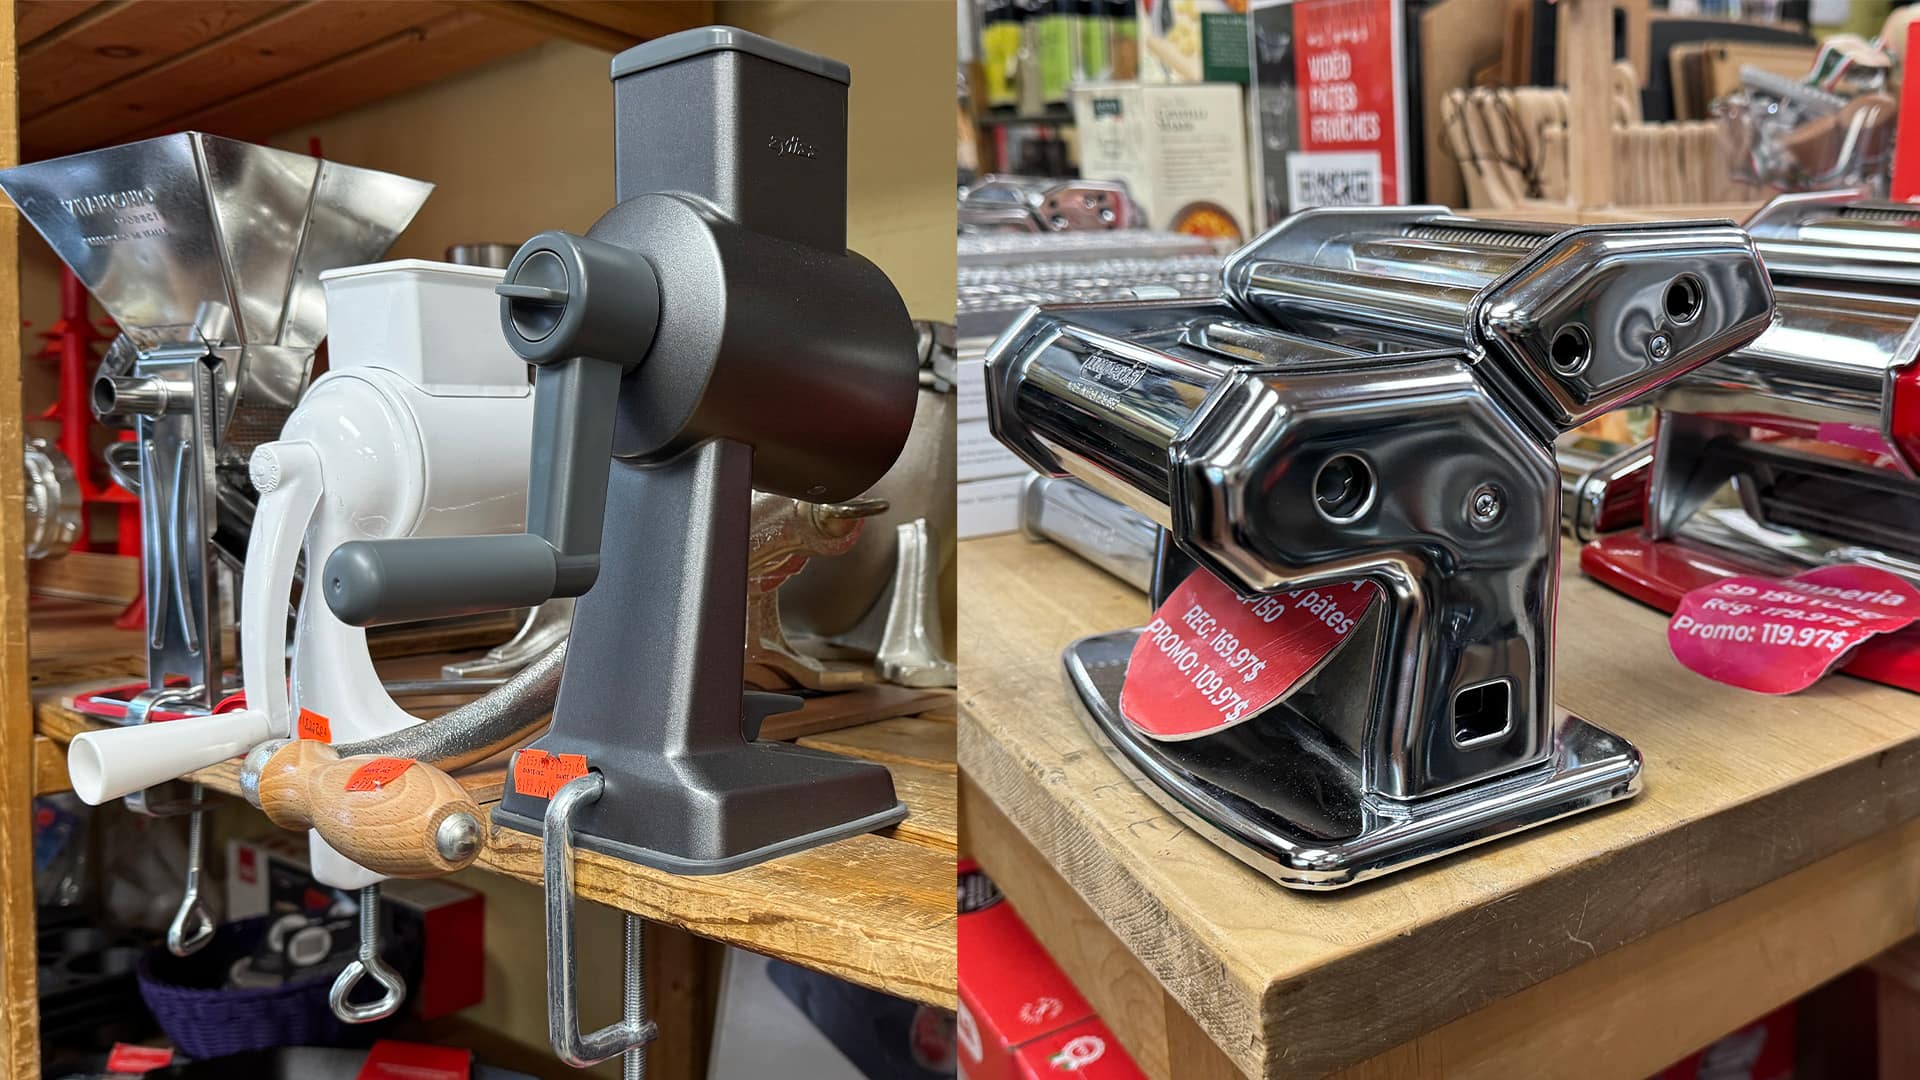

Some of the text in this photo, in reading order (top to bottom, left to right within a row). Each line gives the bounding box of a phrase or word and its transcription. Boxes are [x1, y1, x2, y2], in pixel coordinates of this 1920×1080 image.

[1307, 48, 1352, 82] VIDÉO
[1309, 81, 1358, 112] PÂTES
[1295, 591, 1354, 634] pâtes
[1672, 614, 1849, 652] Promo: 119.97$
[1143, 617, 1249, 722] PROMO: 109.97$
[1209, 628, 1267, 683] 169.97$
